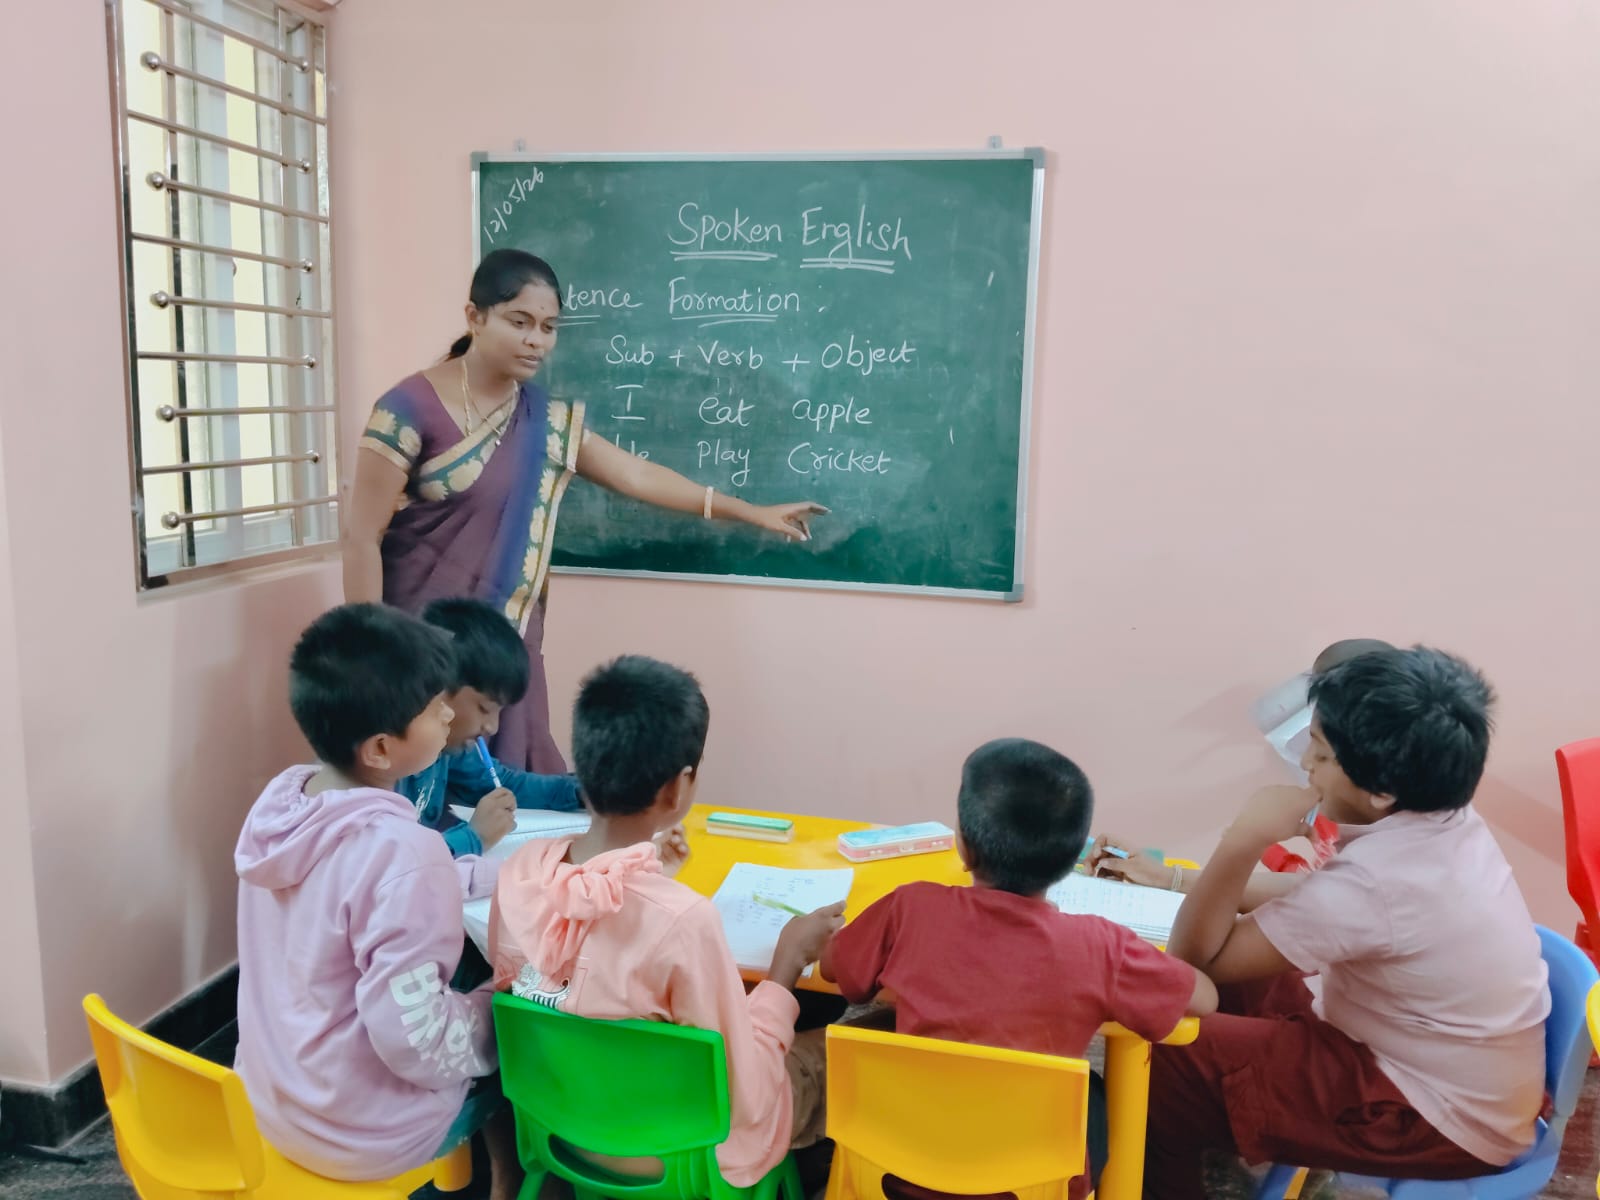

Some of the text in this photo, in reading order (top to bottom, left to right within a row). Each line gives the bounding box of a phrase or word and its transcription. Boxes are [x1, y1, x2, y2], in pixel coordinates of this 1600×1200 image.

[667, 202, 913, 269] Spoken English
[561, 283, 645, 311] tence
[669, 276, 801, 315] Formation
[605, 334, 656, 367] Sub
[698, 340, 765, 370] Verb
[821, 334, 918, 377] Object
[610, 384, 647, 422] I
[697, 440, 752, 488] Play
[787, 442, 893, 475] Cricket
